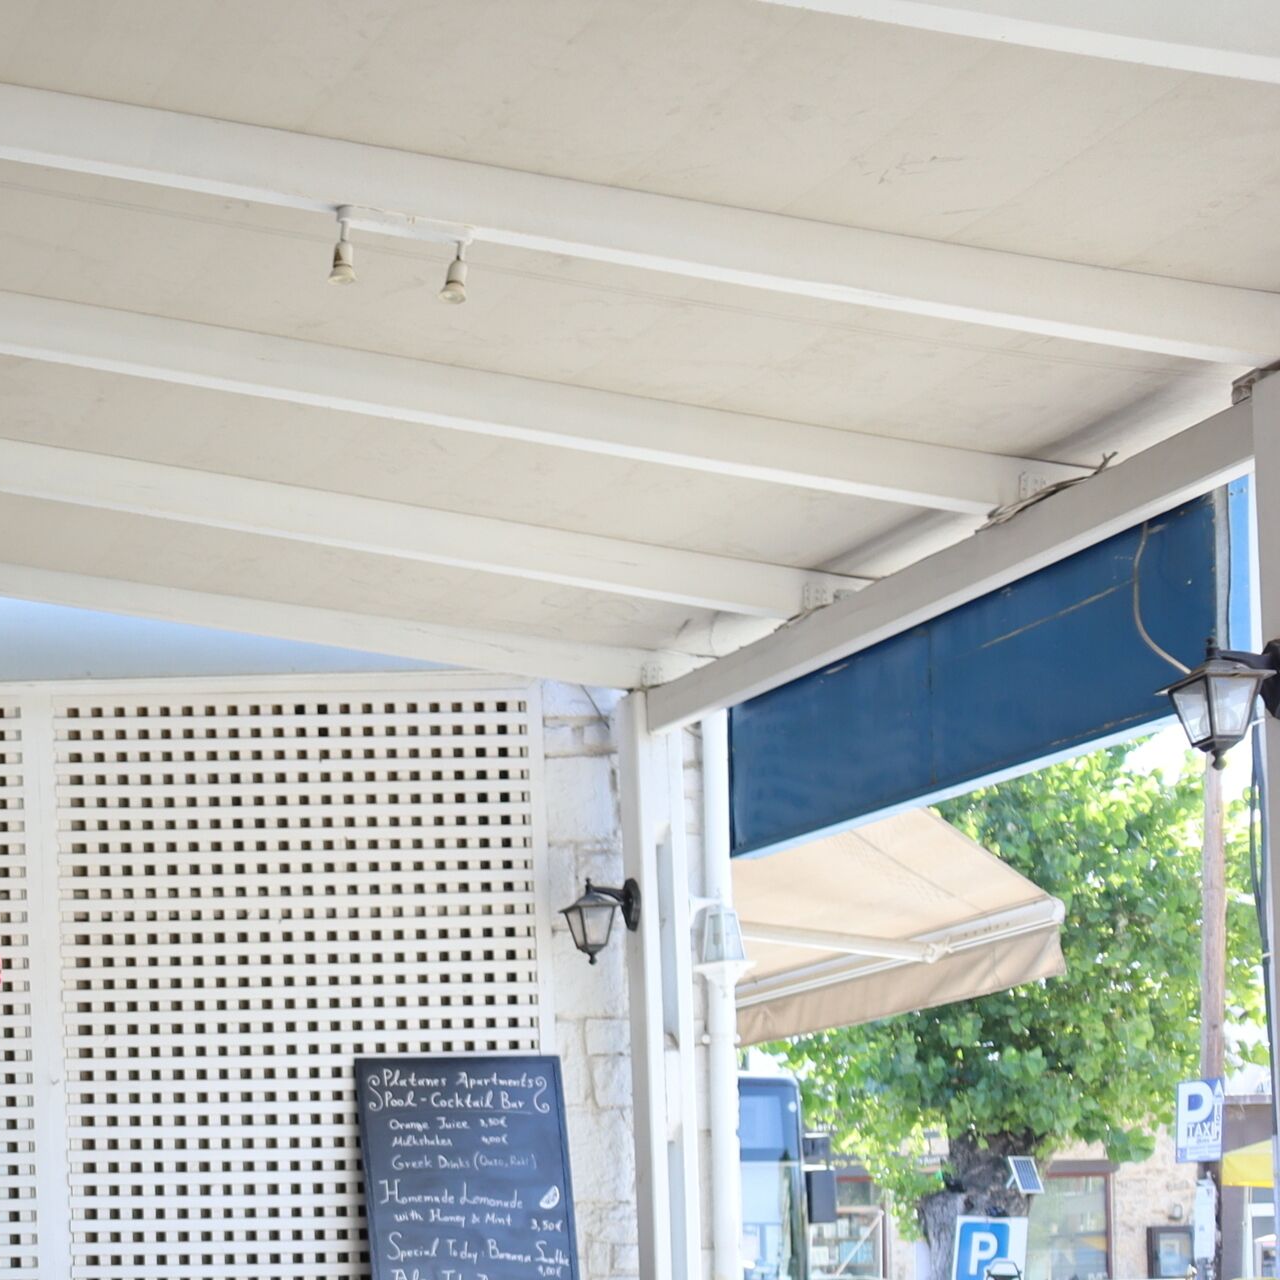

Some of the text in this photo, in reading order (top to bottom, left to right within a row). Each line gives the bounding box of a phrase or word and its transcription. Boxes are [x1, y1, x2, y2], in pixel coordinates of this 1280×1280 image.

[455, 1071, 534, 1089] Apartments
[385, 1090, 417, 1108] Pool
[431, 1090, 493, 1108] Cocktail
[501, 1091, 524, 1109] Bar
[389, 1118, 430, 1132] Orange
[436, 1116, 470, 1129] Juice
[1187, 1121, 1217, 1137] TAXI
[392, 1154, 432, 1170] Greek
[438, 1154, 470, 1169] Drinks
[379, 1179, 523, 1209] Homemade Lemonade
[394, 1208, 424, 1222] with
[430, 1208, 465, 1228] Honey
[485, 1212, 512, 1226] Mint
[530, 1218, 563, 1232] 3,50€
[387, 1231, 439, 1263] Special
[487, 1238, 532, 1263] Banana
[969, 1232, 998, 1276] P
